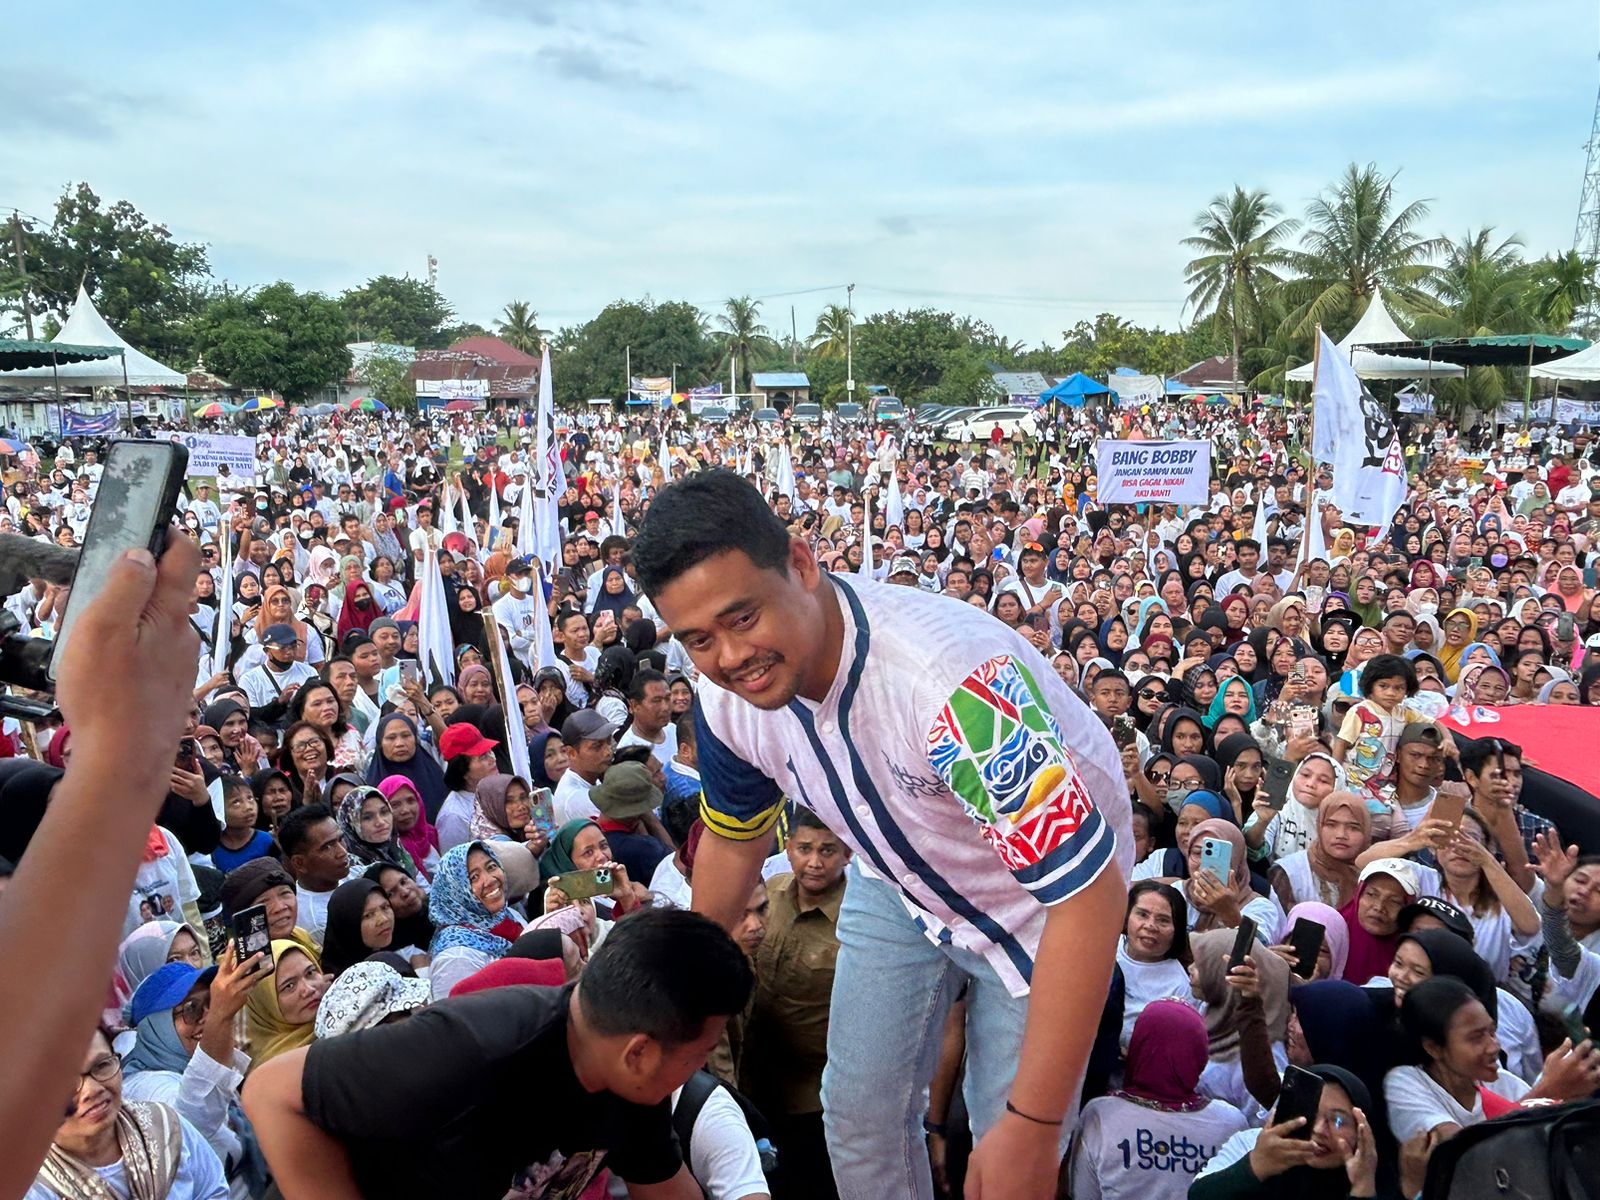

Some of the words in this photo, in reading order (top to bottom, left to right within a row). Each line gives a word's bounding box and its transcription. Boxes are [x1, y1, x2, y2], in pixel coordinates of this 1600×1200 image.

[1112, 451, 1149, 465] BANG
[1151, 450, 1197, 464] BOBBY
[1115, 467, 1142, 476] JANGAN
[1143, 467, 1169, 476] SAMPAI
[1170, 467, 1193, 476] KALAH
[1122, 479, 1138, 487] BISA
[1139, 478, 1162, 487] GAGAL
[1162, 478, 1185, 486] NIKAH
[1136, 1128, 1216, 1160] Bobby
[1117, 1138, 1131, 1170] 1
